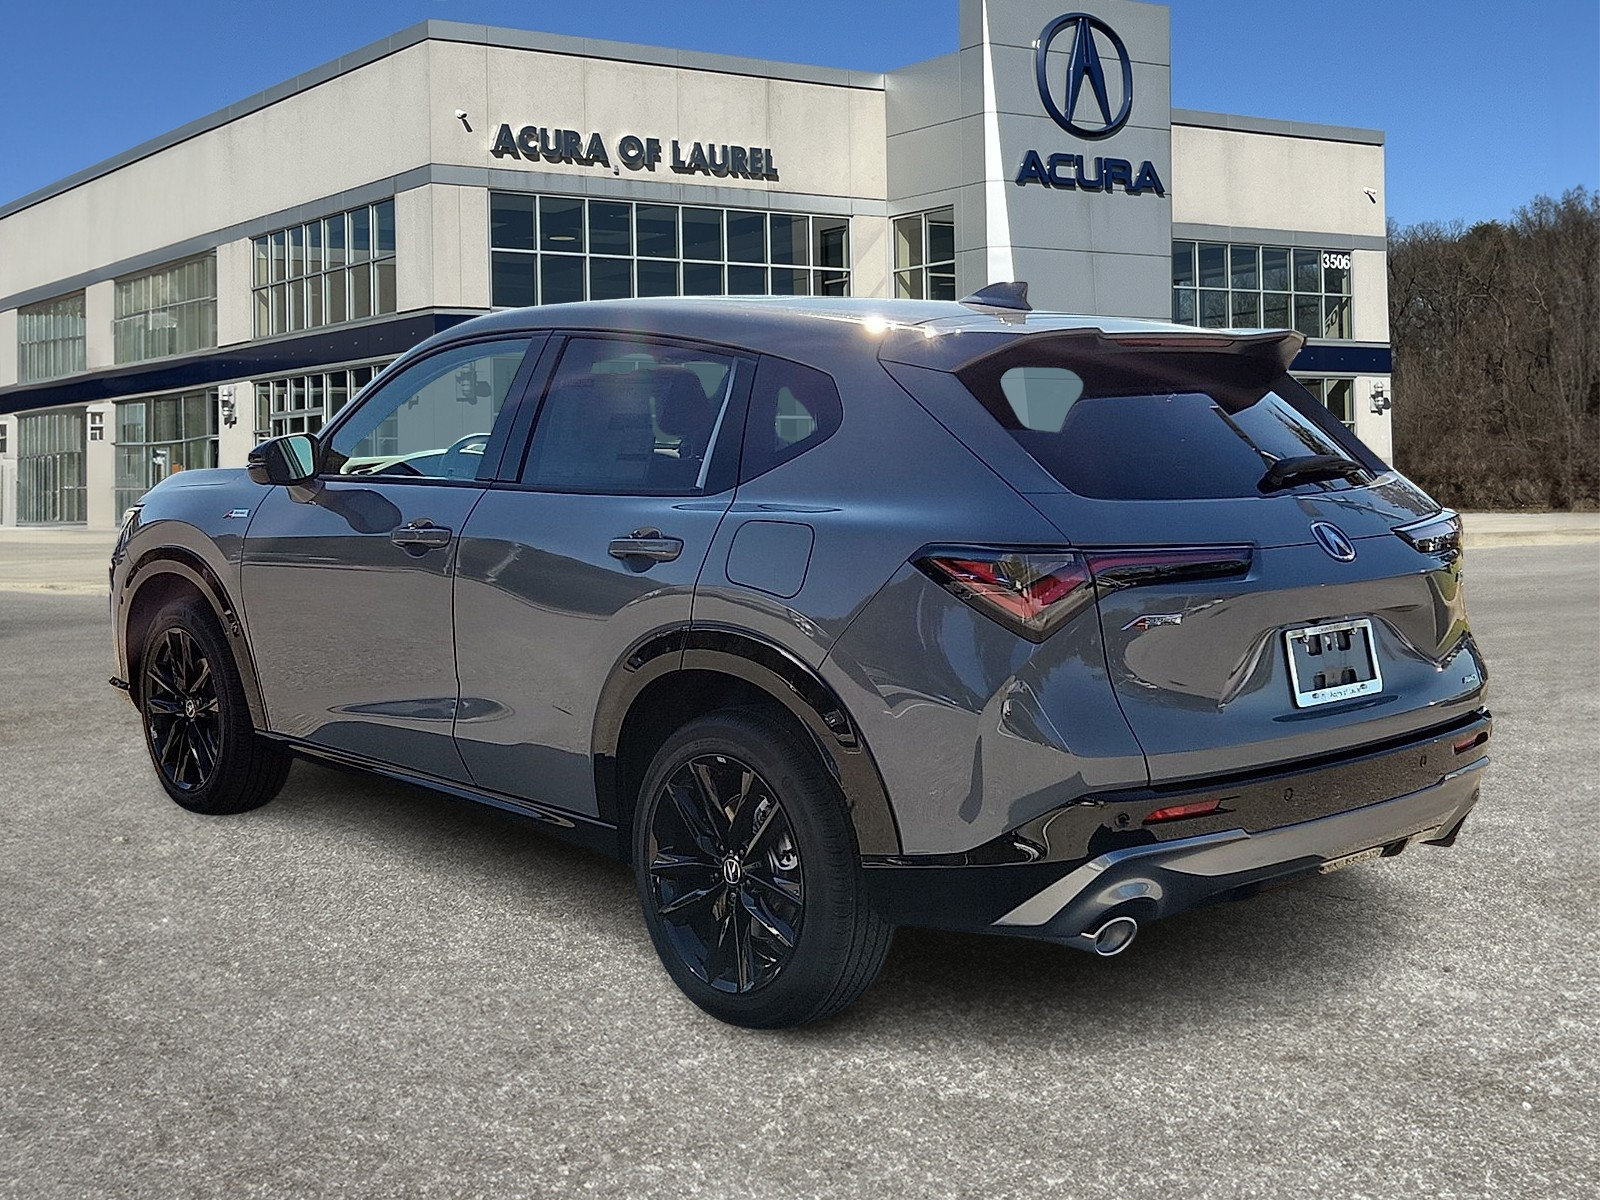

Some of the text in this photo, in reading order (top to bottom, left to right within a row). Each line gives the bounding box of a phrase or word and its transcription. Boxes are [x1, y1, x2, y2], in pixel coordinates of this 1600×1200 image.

[491, 123, 779, 180] ACURA OF LAUREL
[1016, 150, 1166, 197] ACURA
[1322, 253, 1351, 270] 3506
